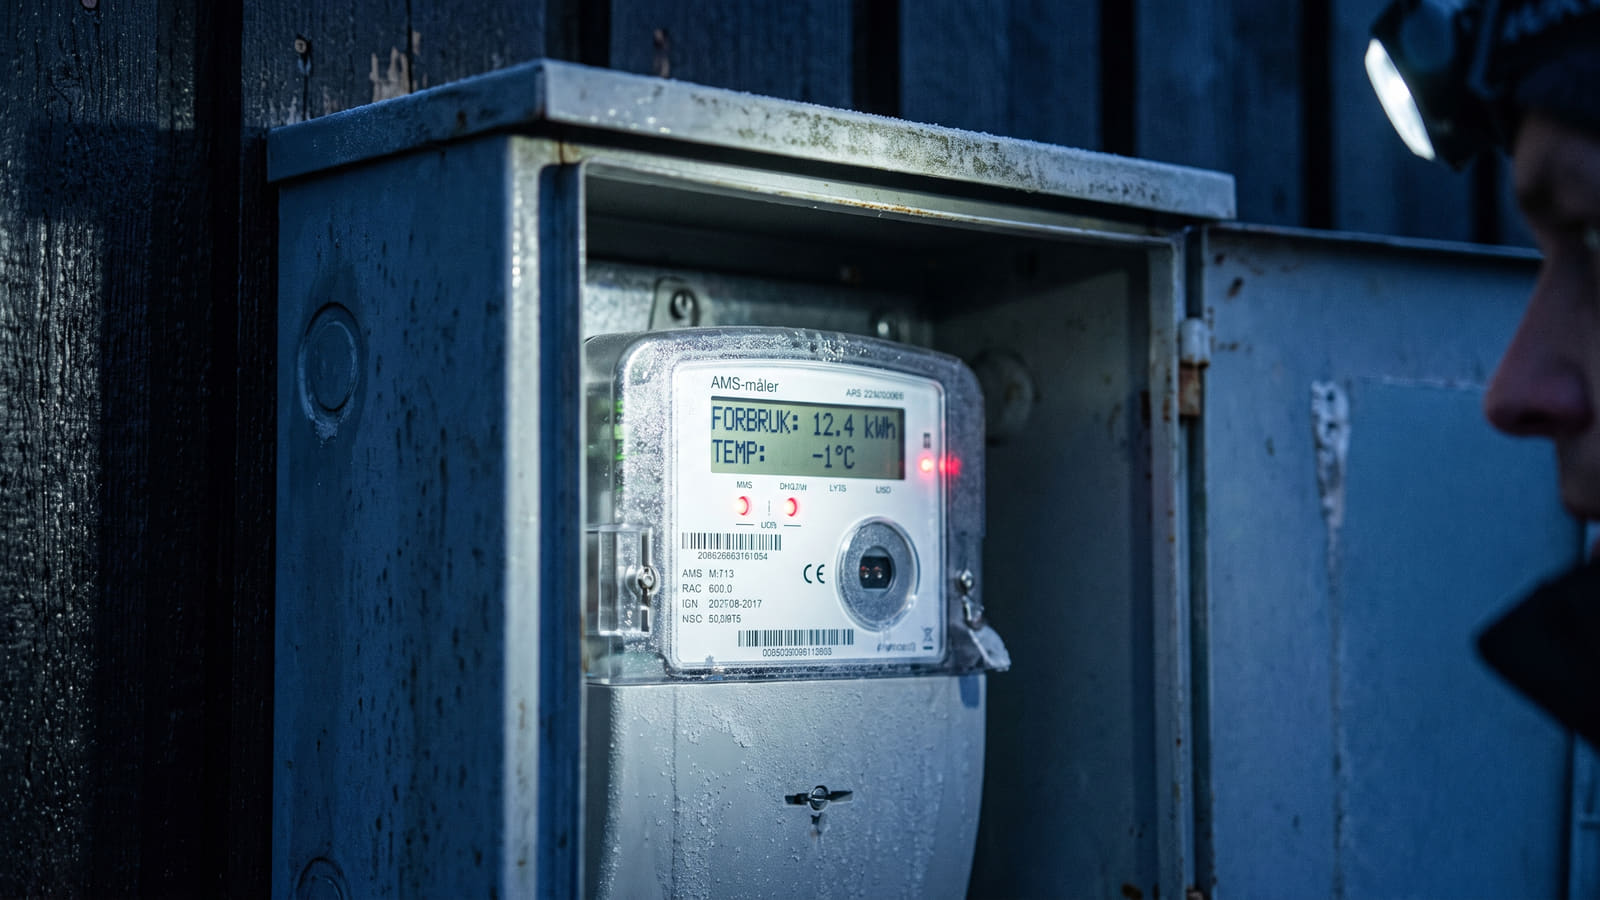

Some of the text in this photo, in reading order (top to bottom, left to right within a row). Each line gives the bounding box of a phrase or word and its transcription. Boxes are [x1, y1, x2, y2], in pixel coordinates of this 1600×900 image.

[710, 375, 779, 393] AMS-måler
[712, 406, 896, 440] FORBRUK: 12.4 kWh
[712, 439, 855, 470] TEMP: -1°C
[682, 568, 703, 578] AMS
[682, 583, 732, 593] RAC 600.0
[682, 598, 698, 608] IGN
[682, 614, 703, 623] NSC
